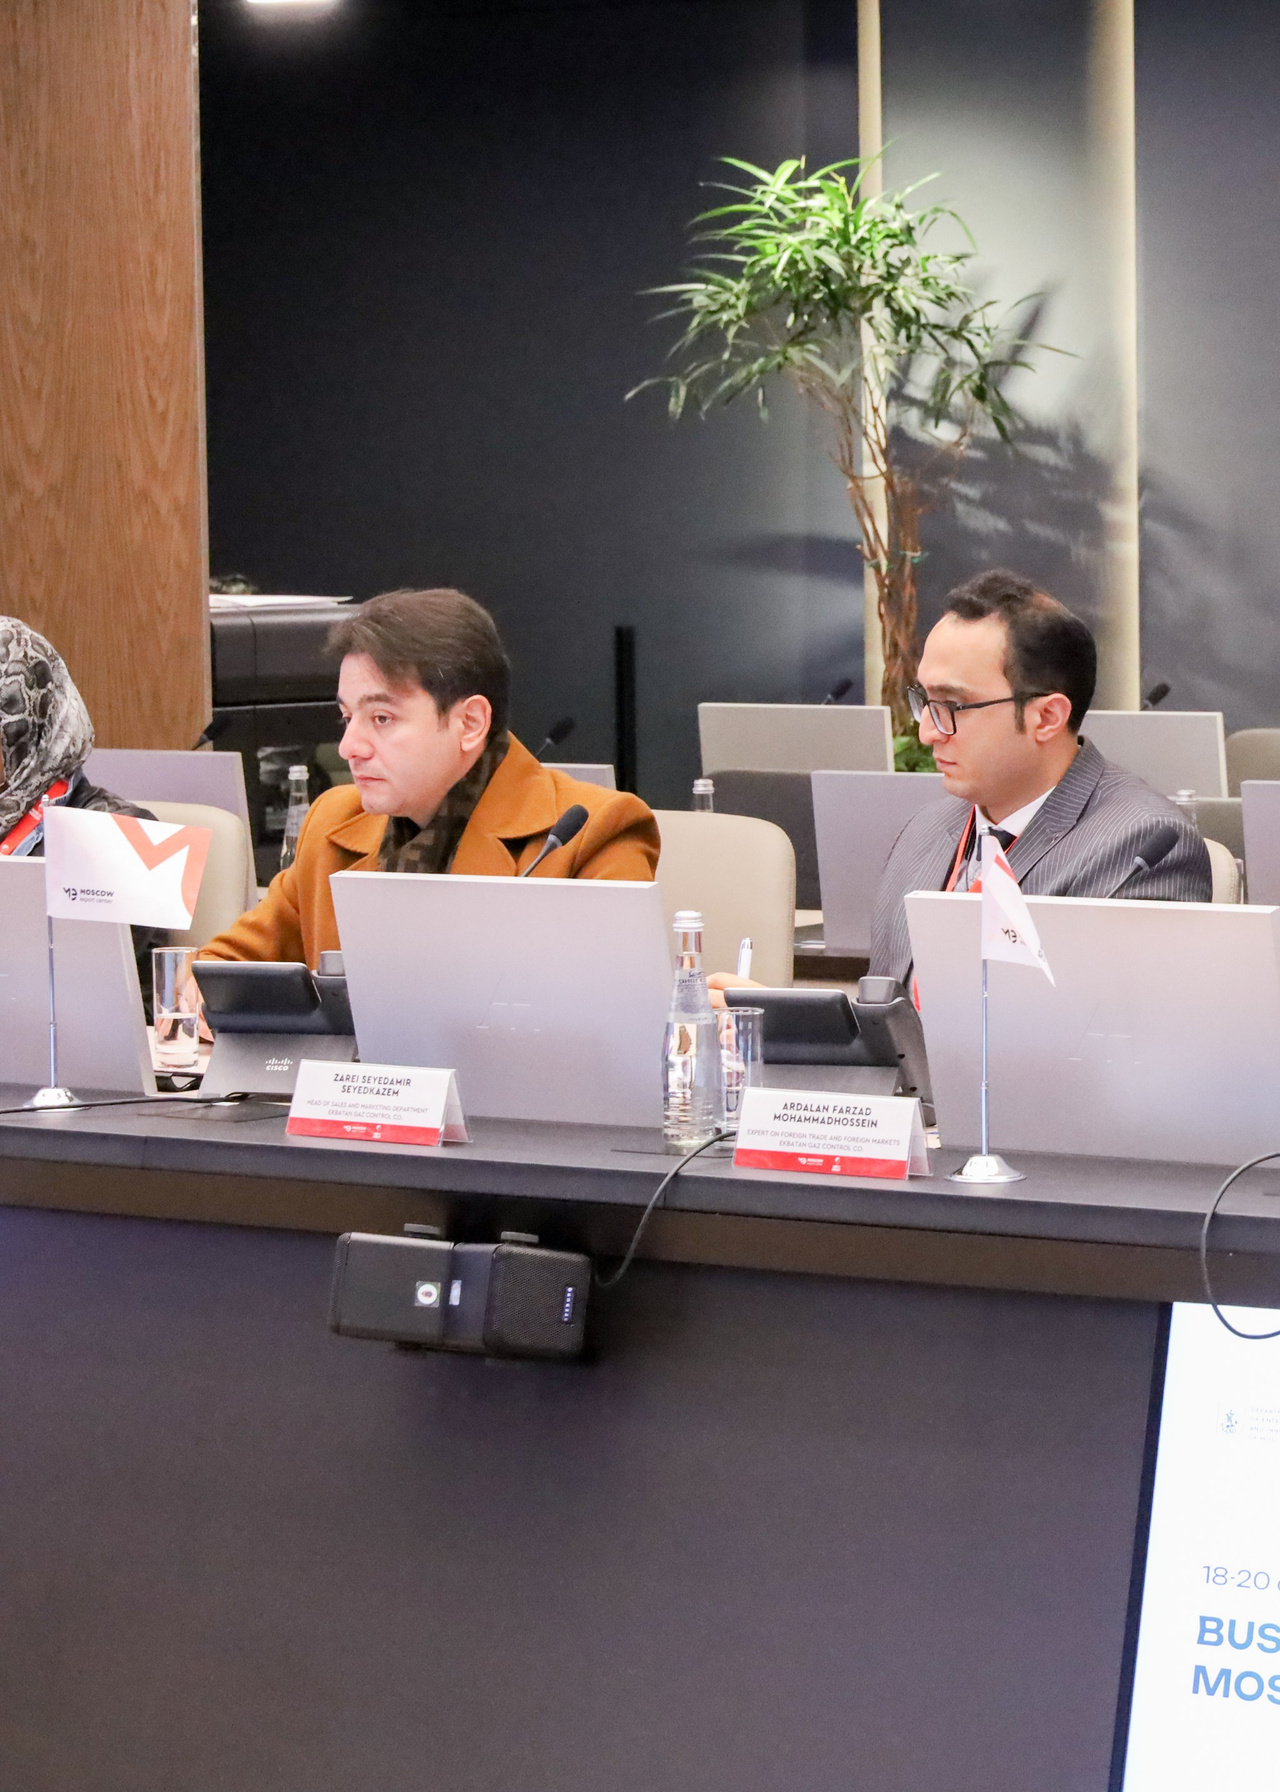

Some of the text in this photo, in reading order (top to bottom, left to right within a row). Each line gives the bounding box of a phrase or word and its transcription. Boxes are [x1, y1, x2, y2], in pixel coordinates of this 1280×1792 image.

[80, 889, 114, 897] MOSCOW
[333, 1073, 411, 1086] ZAREI SEYEDAMIR
[341, 1084, 399, 1096] SEYEDKAZEM
[360, 1103, 391, 1111] MARKETING
[782, 1102, 871, 1115] ARDALAN FARZAD
[773, 1113, 877, 1127] MOHAMMADHOSSEIN
[1201, 1564, 1270, 1591] 18-20
